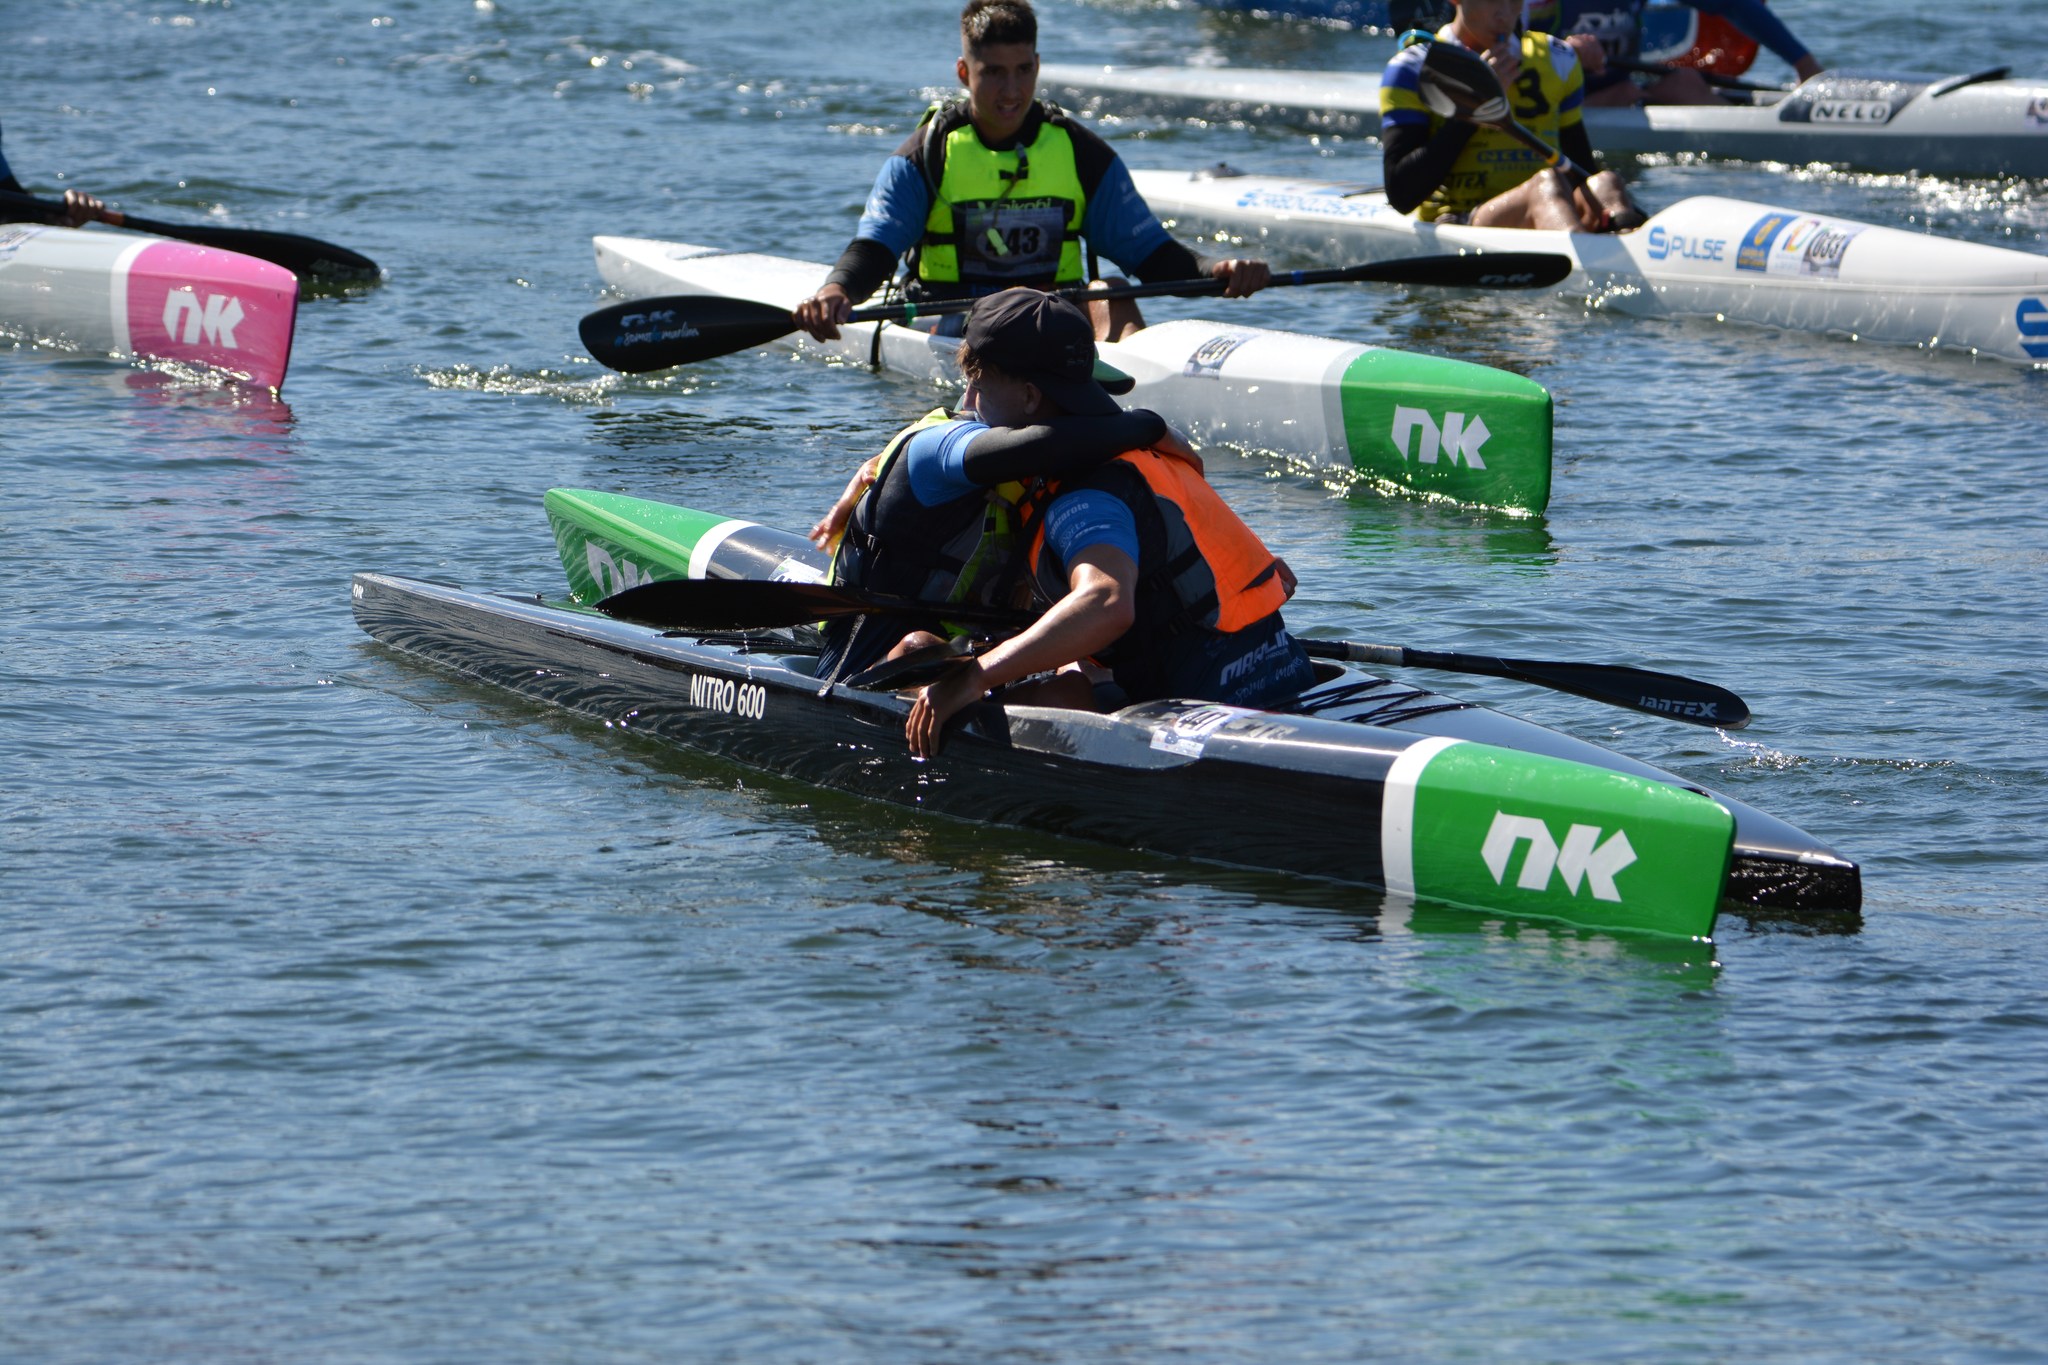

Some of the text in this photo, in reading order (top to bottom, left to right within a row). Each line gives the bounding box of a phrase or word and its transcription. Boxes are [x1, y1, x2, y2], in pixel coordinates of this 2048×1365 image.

[1815, 104, 1888, 120] NELO
[690, 674, 766, 720] NITRO 600
